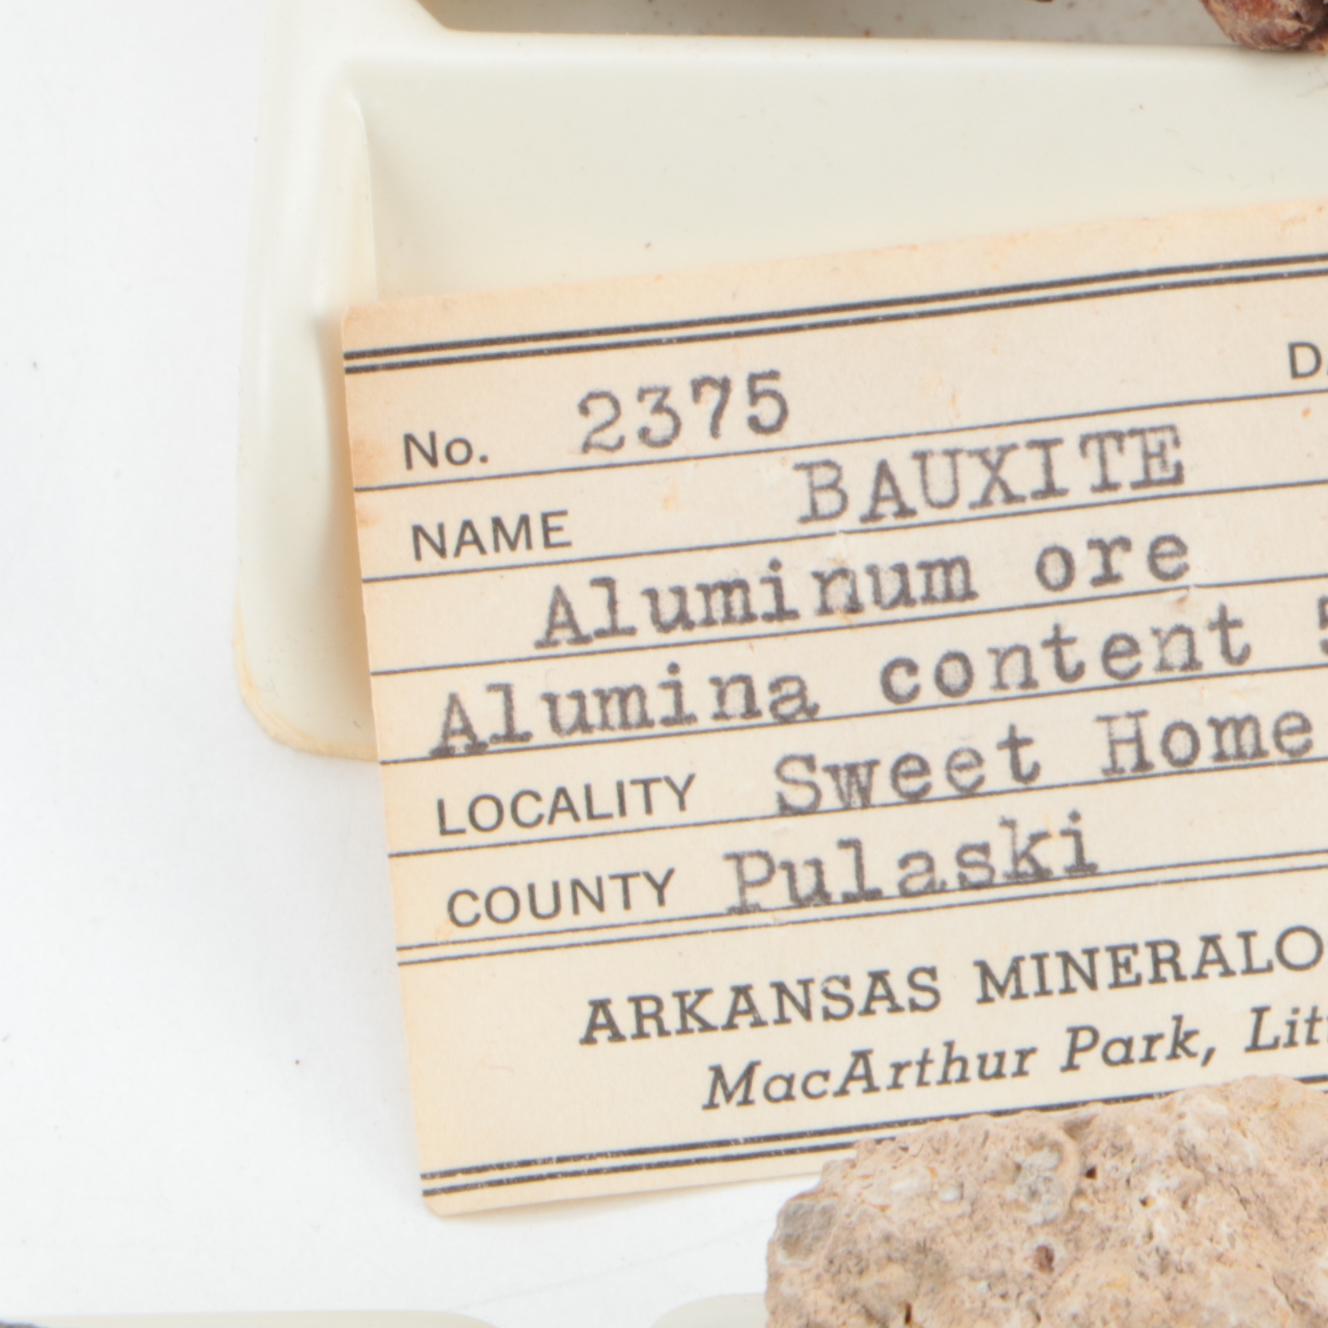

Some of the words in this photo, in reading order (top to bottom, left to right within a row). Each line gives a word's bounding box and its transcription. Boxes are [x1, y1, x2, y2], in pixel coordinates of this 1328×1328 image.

[403, 432, 490, 471] No.
[577, 370, 790, 455] 2375
[412, 509, 573, 562] NAME
[794, 426, 1185, 526] BAUXITE
[534, 554, 979, 650] Aluminum
[1035, 532, 1191, 592] ore
[430, 664, 820, 758] Alumina
[880, 604, 1253, 706] content
[436, 772, 698, 836] LOCALITY
[774, 724, 1043, 815] Sweet
[1095, 708, 1315, 777] Home
[447, 867, 676, 927] COUNTY
[723, 810, 1099, 915] Pulaski
[579, 965, 941, 1046] ARKANSAS
[702, 1040, 1037, 1110] MacArthur
[1060, 1016, 1217, 1072] Park,
